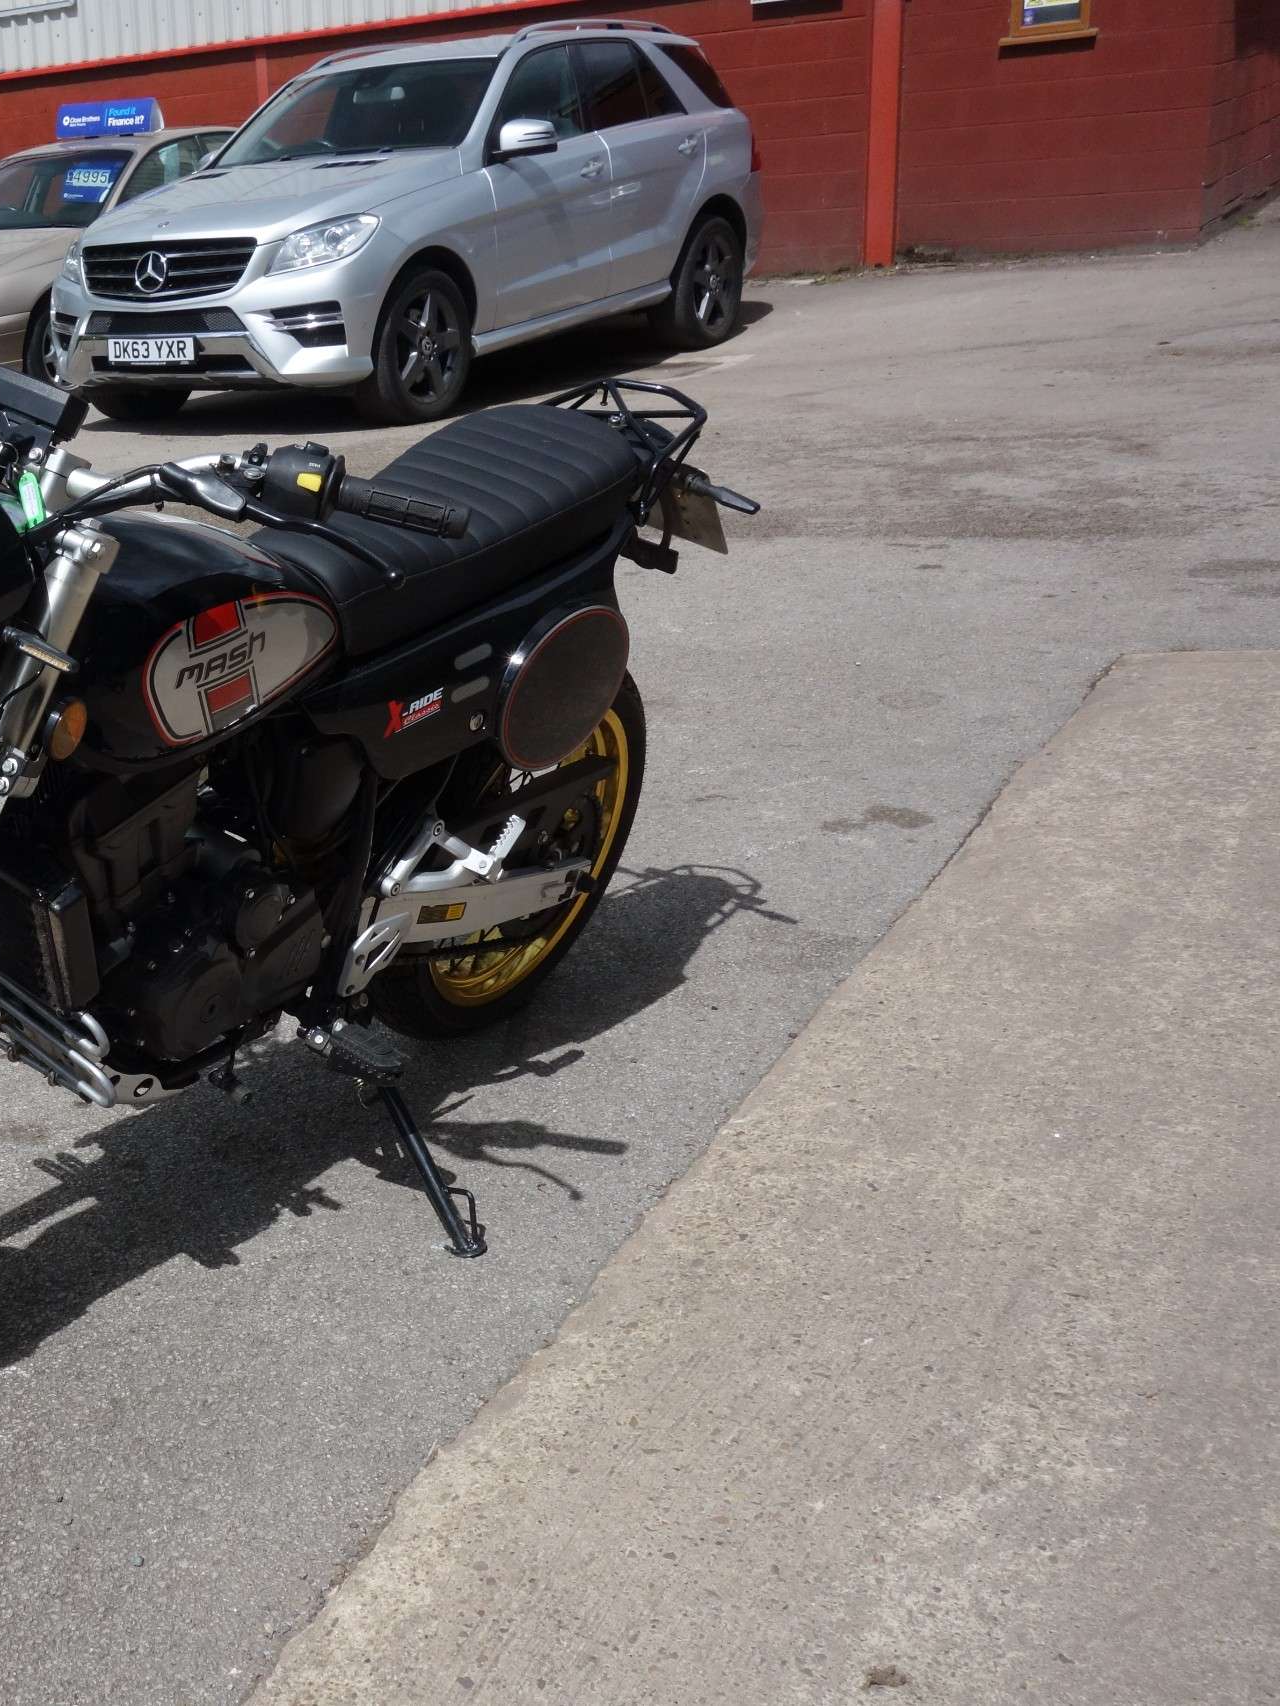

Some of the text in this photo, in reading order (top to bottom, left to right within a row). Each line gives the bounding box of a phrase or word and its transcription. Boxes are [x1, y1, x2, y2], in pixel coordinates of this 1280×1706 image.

[108, 107, 131, 117] Found
[107, 115, 145, 127] Finance it?
[113, 340, 187, 359] DK63 YXR
